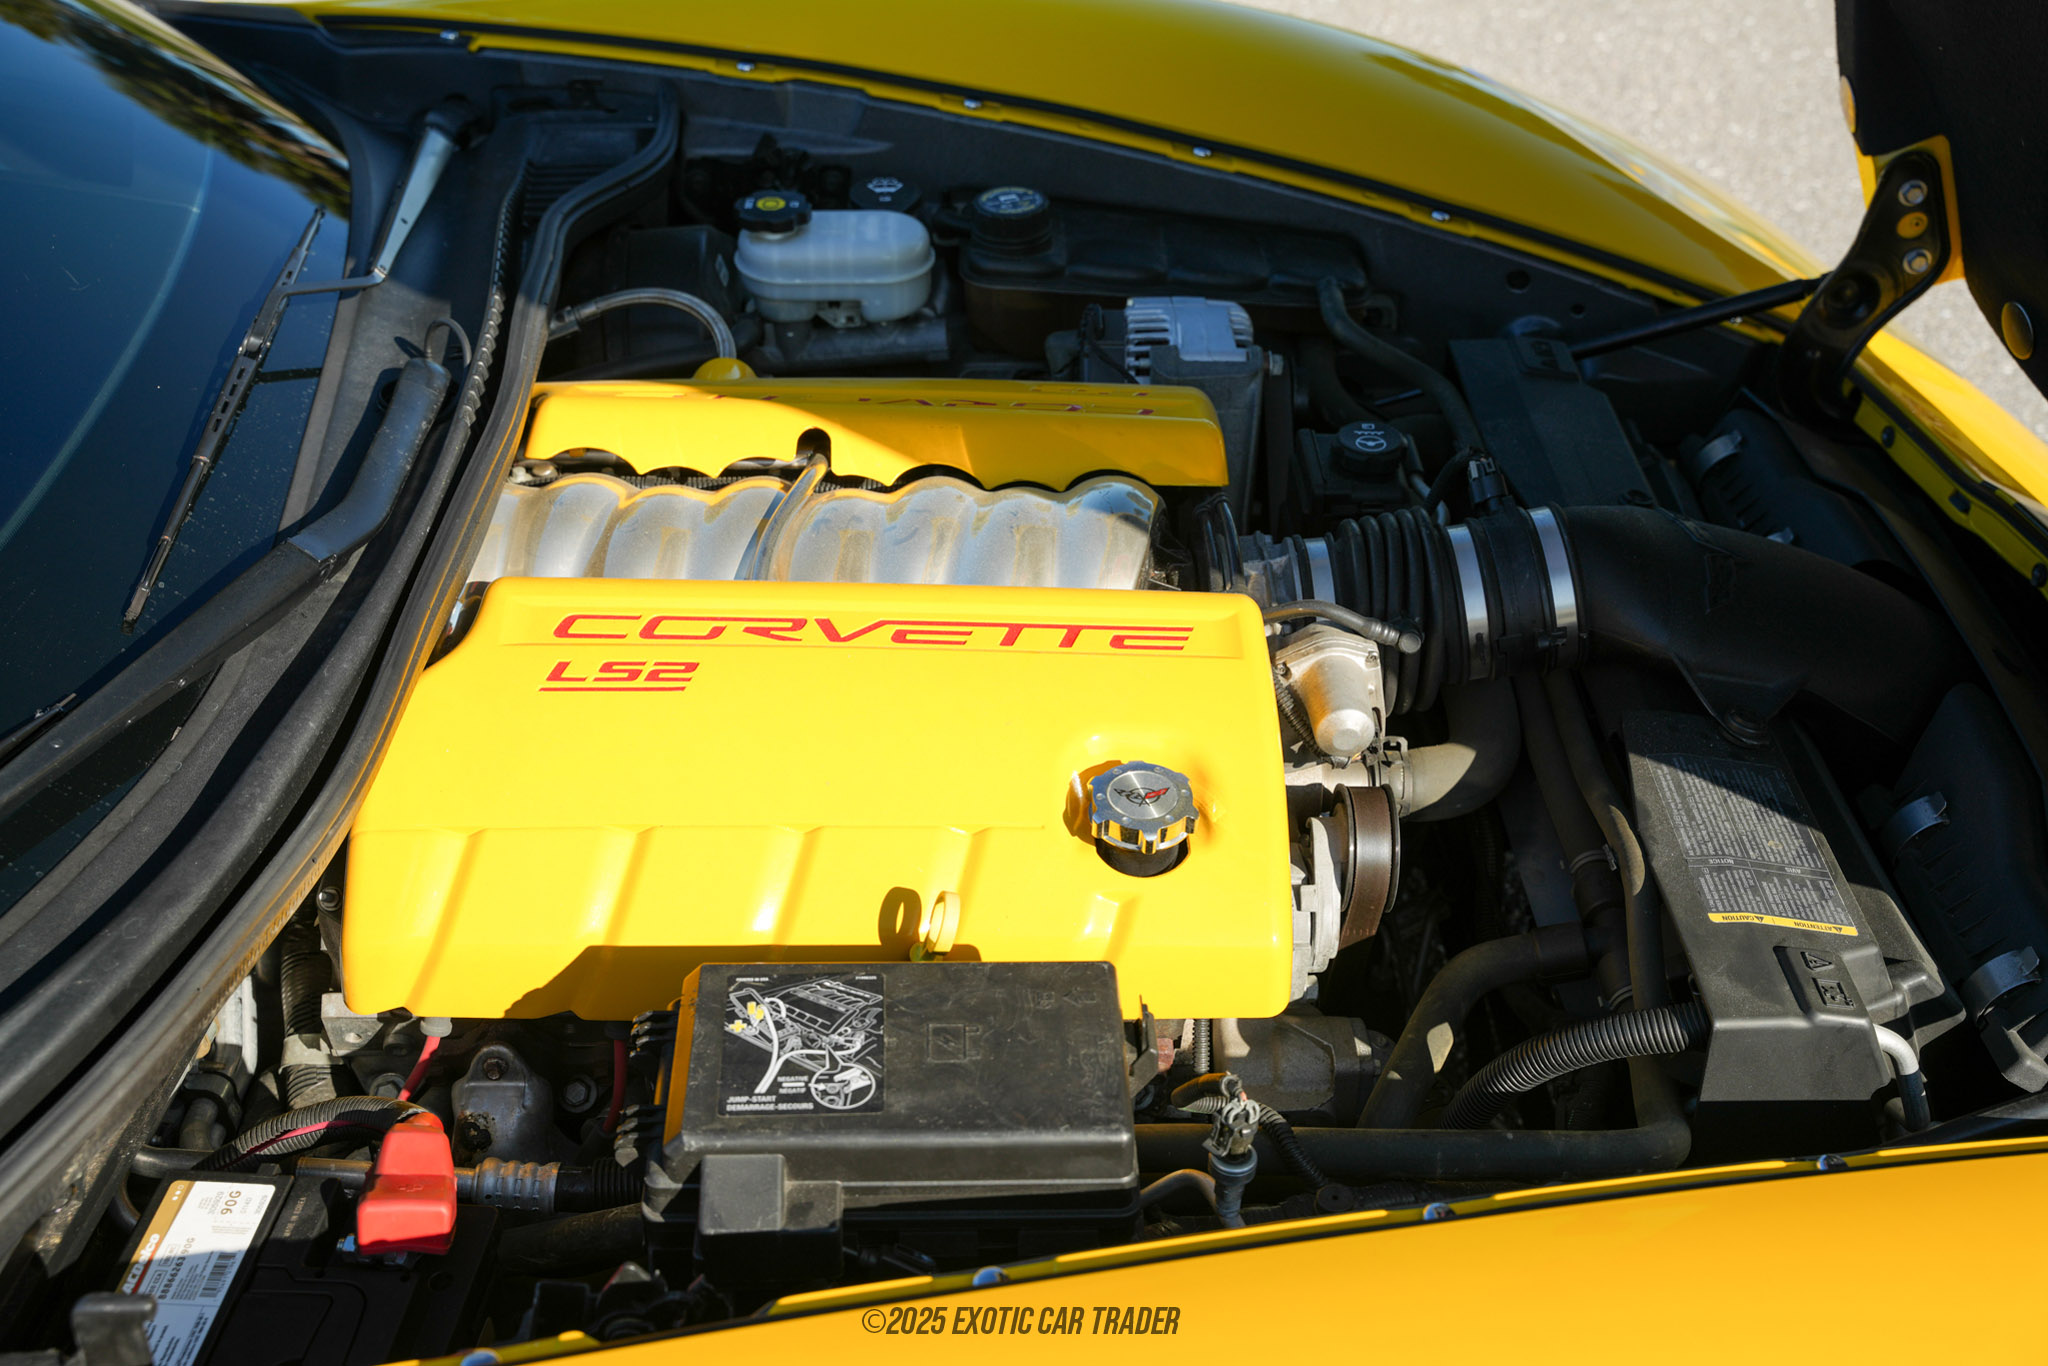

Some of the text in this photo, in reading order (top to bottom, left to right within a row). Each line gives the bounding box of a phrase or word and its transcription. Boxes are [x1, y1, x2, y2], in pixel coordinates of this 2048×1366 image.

[552, 613, 1194, 651] CORVETTE
[545, 660, 700, 682] LS2
[1793, 921, 1833, 932] ATTENTION
[726, 1095, 776, 1103] JUMP-START
[220, 1190, 242, 1215] 90G
[121, 1233, 161, 1295] ACDelco
